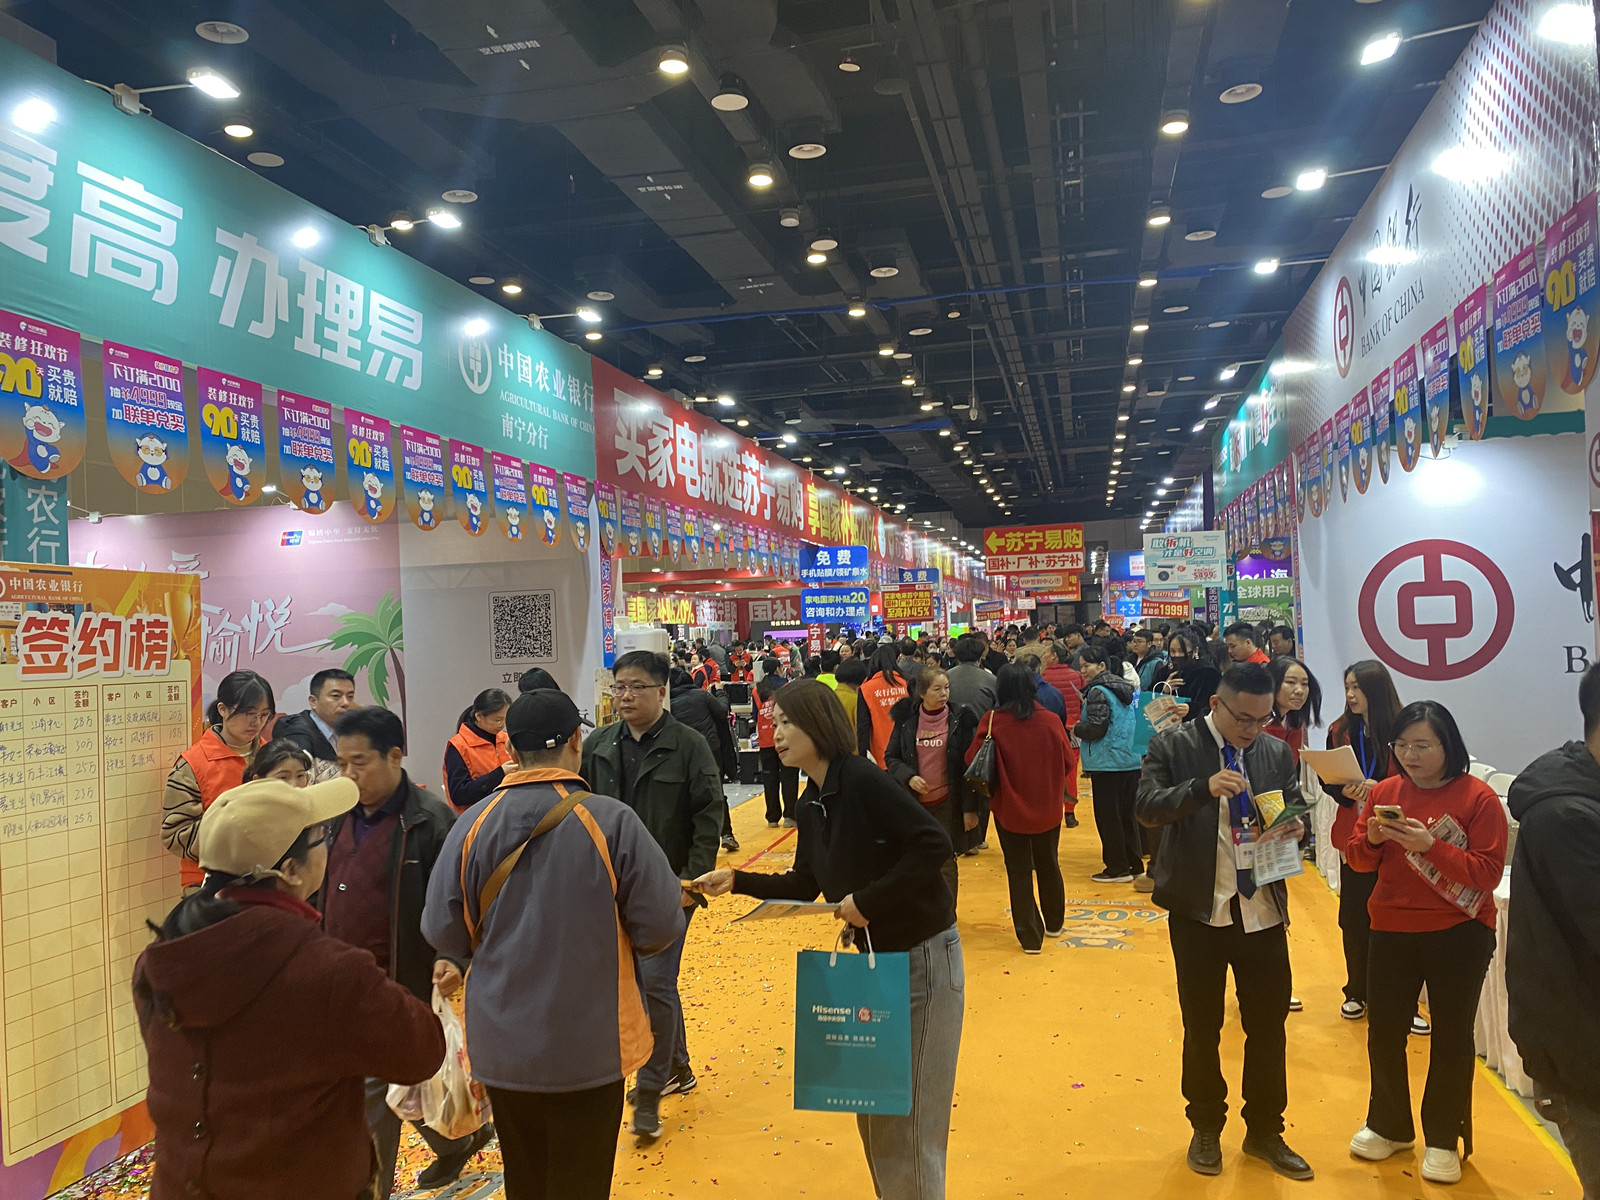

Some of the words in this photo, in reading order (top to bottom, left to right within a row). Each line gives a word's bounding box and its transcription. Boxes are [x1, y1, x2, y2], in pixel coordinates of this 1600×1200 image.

[1550, 219, 1591, 266] 装修狂欢节
[1578, 243, 1595, 273] 买贵
[1496, 268, 1538, 309] 下订满2000
[1545, 259, 1576, 313] 90
[1578, 266, 1596, 296] 就赔
[208, 226, 424, 391] 办理易
[1361, 320, 1380, 358] BANK
[1382, 307, 1392, 336] OF
[1394, 277, 1425, 324] CHINA
[0, 332, 69, 363] 装修狂欢节
[1459, 334, 1475, 375] 90
[47, 365, 77, 389] 买贵
[109, 361, 181, 393] 下订满2000
[498, 343, 593, 412] 中国农业银行
[48, 383, 78, 407] 就赔
[207, 386, 255, 410] 装修狂欢节
[1395, 384, 1408, 417] 90
[112, 403, 185, 433] 加联单兑奖
[281, 406, 330, 430] 下订满2000
[500, 390, 551, 418] AGRICULTURAL
[552, 410, 569, 425] BANK
[570, 417, 578, 427] OF
[202, 403, 239, 440] 90
[240, 411, 259, 430] 买贵
[501, 412, 548, 450] 南宁分行
[241, 426, 260, 445] 就赔
[351, 424, 385, 442] 装修狂欢节
[348, 438, 372, 468] 90
[373, 444, 389, 459] 买贵
[613, 387, 805, 532] 买家电就选苏宁易购
[451, 464, 472, 490] 90
[1005, 528, 1083, 552] 苏宁易购
[1152, 536, 1191, 549] 敢拆机
[816, 549, 852, 566] 免费
[988, 554, 1082, 570] 国补·厂补·苏宁补
[1163, 547, 1215, 557] 才是好空调
[800, 567, 868, 578] 手机贴膜/领矿泉水
[902, 571, 928, 582] 免费
[9, 577, 83, 593] 中国农业银行
[626, 596, 695, 625] 享国家补贴20%
[748, 600, 798, 621] 国补
[805, 606, 866, 618] 咨询和办理点
[887, 607, 930, 618] 至高补45%
[17, 612, 172, 681] 签约榜
[74, 690, 90, 700] 签约
[107, 692, 121, 702] 客户
[133, 691, 152, 699] 小区
[168, 685, 180, 694] 签约
[1, 699, 18, 709] 客户
[33, 696, 56, 706] 小区
[74, 699, 90, 709] 金额
[73, 716, 93, 730] 28万
[75, 738, 93, 752] 30万
[916, 738, 943, 747] LOUD
[75, 761, 97, 775] 25万
[74, 787, 94, 801] 23万
[74, 812, 93, 825] 25万
[812, 1004, 852, 1015] Hisense
